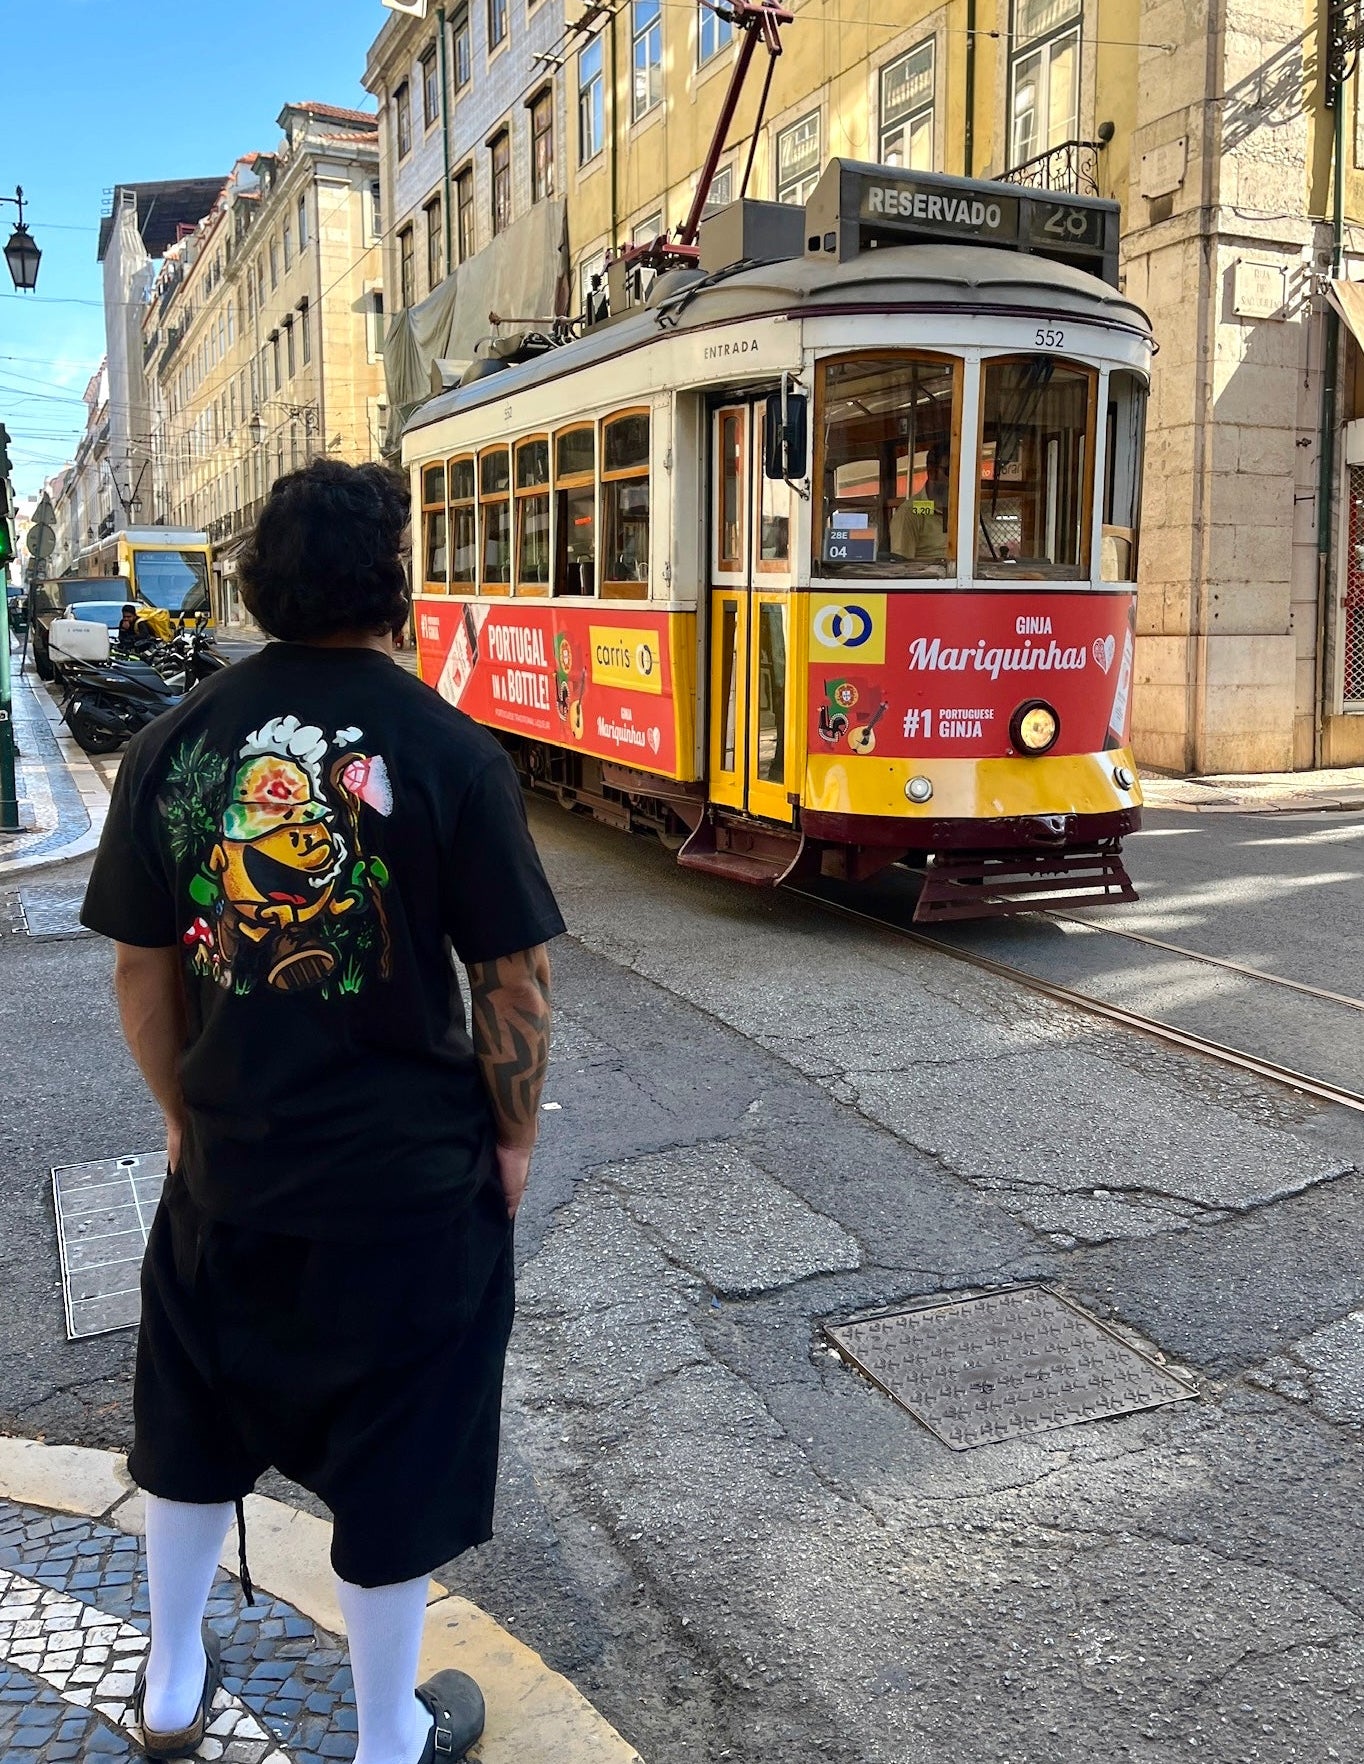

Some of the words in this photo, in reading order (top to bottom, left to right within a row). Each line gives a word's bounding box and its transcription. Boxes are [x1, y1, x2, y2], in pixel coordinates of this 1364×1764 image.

[868, 186, 1001, 229] RESERVADO
[704, 339, 759, 360] ENTRADA
[1035, 329, 1065, 348] 552
[830, 531, 848, 540] 28E
[829, 546, 848, 558] 04
[1015, 616, 1052, 635] GINJA
[487, 624, 548, 668] PORTUGAL
[596, 634, 631, 668] carris
[908, 637, 1087, 681] Mariquinhas
[507, 668, 551, 711] BOTTLE!
[903, 708, 933, 738] #1
[939, 708, 994, 720] PORTUGUESE
[596, 716, 646, 747] Mariquinhas
[939, 720, 983, 738] GINJA
